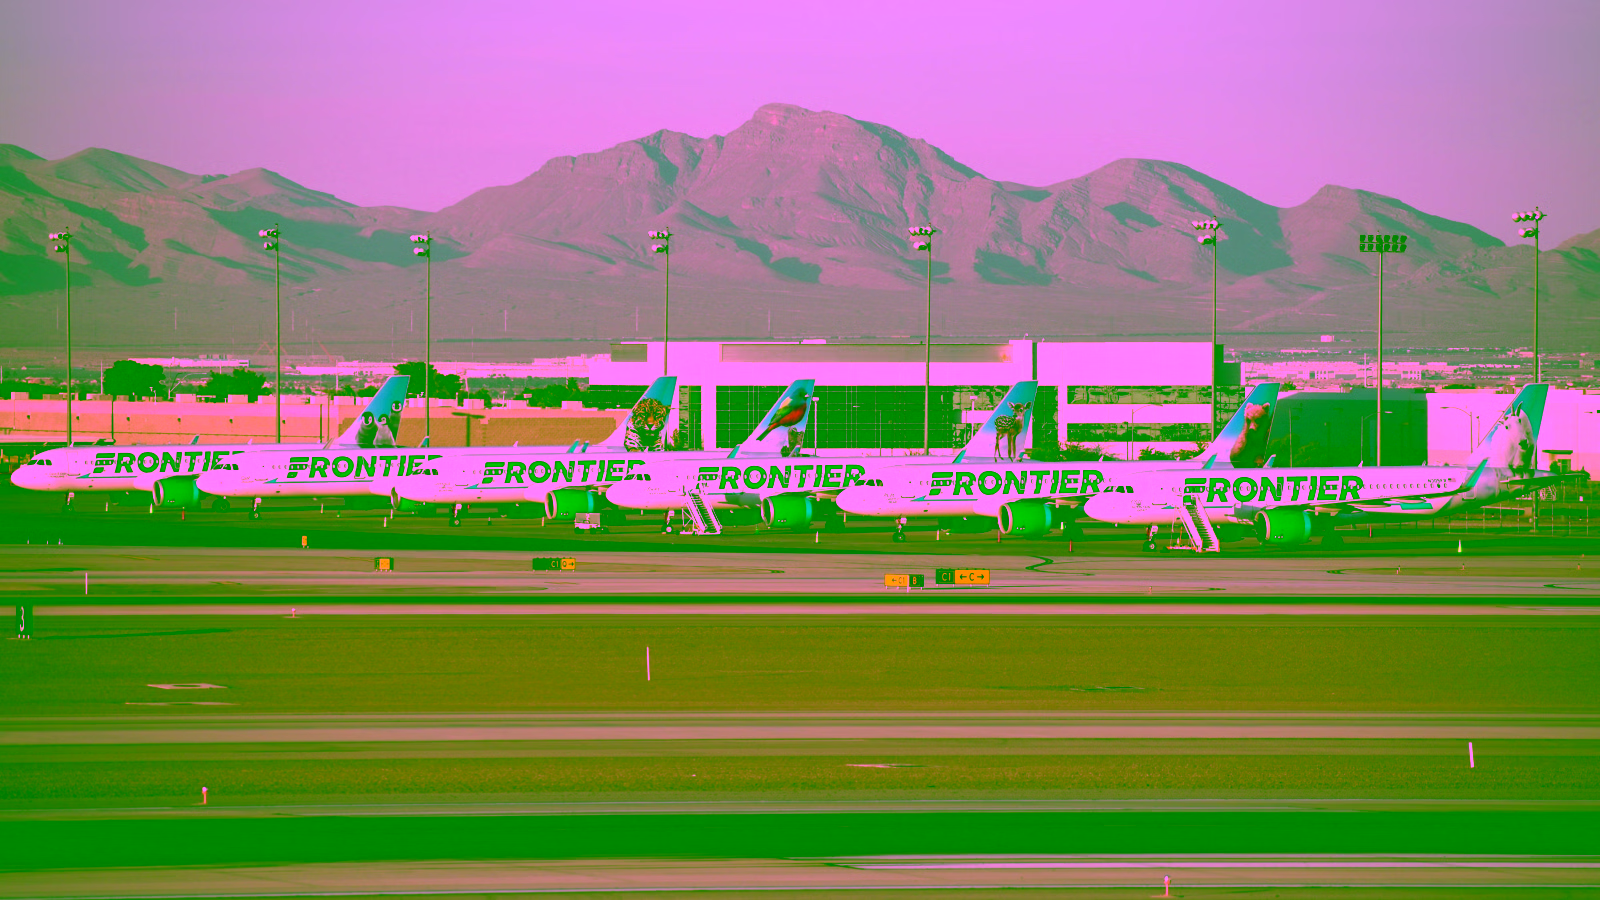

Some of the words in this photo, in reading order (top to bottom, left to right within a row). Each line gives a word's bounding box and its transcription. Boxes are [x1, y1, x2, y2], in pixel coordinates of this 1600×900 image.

[93, 451, 245, 473] FRONTIE
[287, 455, 443, 478] FRONTIE
[696, 464, 865, 489] FRONTIER
[929, 470, 1104, 495] FRONTIER
[1183, 475, 1363, 502] FRONTIER
[969, 573, 974, 581] C
[19, 606, 25, 632] 3
